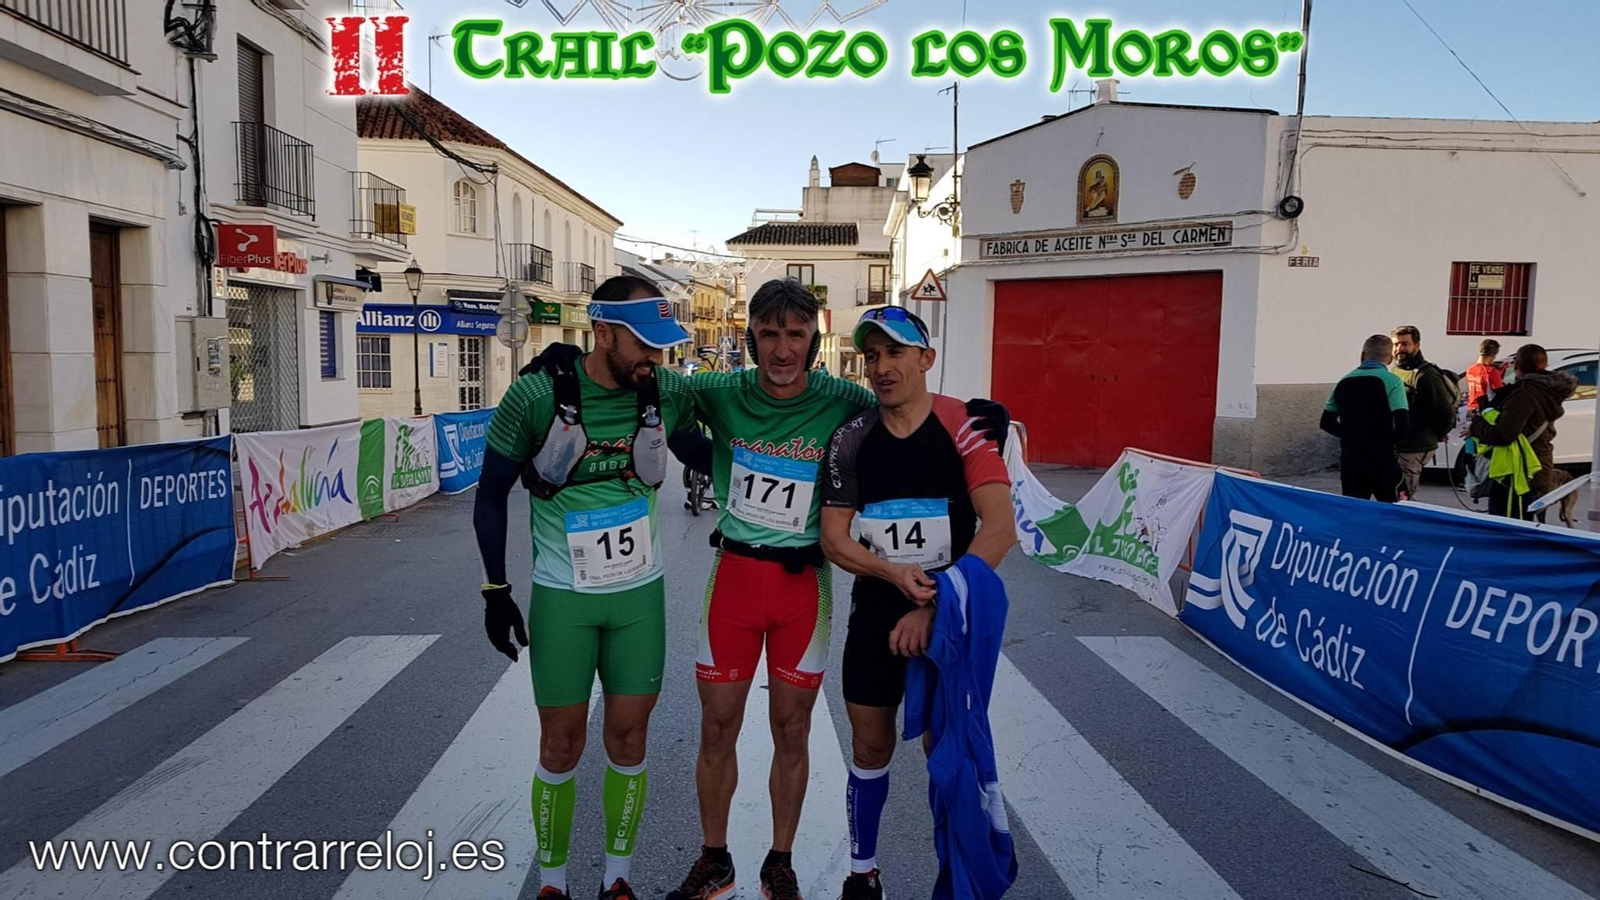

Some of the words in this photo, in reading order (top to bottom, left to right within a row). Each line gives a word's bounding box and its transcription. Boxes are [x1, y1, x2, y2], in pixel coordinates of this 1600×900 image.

[986, 240, 1029, 255] FABRICA
[1034, 239, 1049, 252] DE
[1054, 236, 1093, 251] ACEITE
[1143, 231, 1166, 246] DEL
[1172, 226, 1227, 244] CARMEN
[220, 253, 272, 264] FiberPlus
[1289, 257, 1319, 267] FERIA
[1471, 265, 1480, 274] SE
[1482, 265, 1504, 274] VENDE
[357, 311, 415, 327] Allianz
[456, 321, 474, 329] Allianz
[475, 321, 496, 331] Seguros
[730, 436, 826, 461] maratón
[743, 473, 796, 509] 171
[0, 472, 119, 545] iputación
[140, 469, 227, 510] DEPORTES
[597, 526, 634, 560] 15
[885, 521, 926, 550] 14
[0, 577, 16, 616] e
[29, 544, 100, 604] Cádiz
[1271, 522, 1418, 613] Diputación
[1445, 579, 1600, 674] DEPOR
[1255, 596, 1288, 648] de
[1295, 609, 1366, 690] Cádiz
